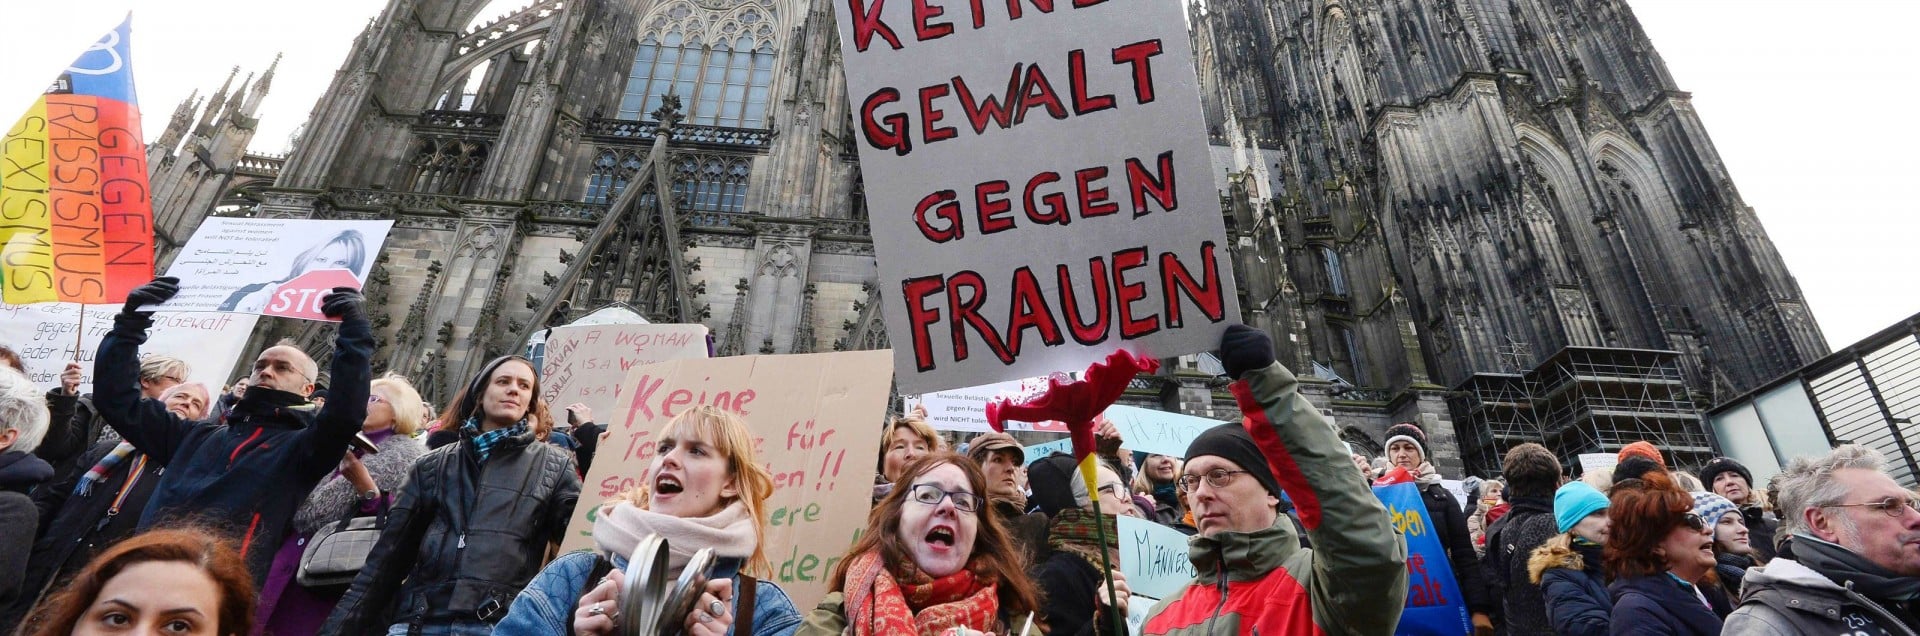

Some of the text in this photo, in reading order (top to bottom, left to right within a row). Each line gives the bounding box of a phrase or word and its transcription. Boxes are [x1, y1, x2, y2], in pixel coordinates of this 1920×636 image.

[860, 38, 1164, 156] GEWALT
[97, 127, 147, 266] GEGEN
[913, 150, 1178, 244] GEGEN
[167, 312, 232, 332] Gewalt
[270, 288, 333, 314] STO
[901, 240, 1226, 373] FRAUEN
[33, 321, 81, 341] gegen
[542, 339, 580, 384] SEXUAL
[542, 362, 573, 405] SSAULT
[624, 374, 757, 430] Keine
[787, 419, 836, 451] für
[1125, 412, 1203, 445] HÄND
[1134, 529, 1189, 580] MÄNNER
